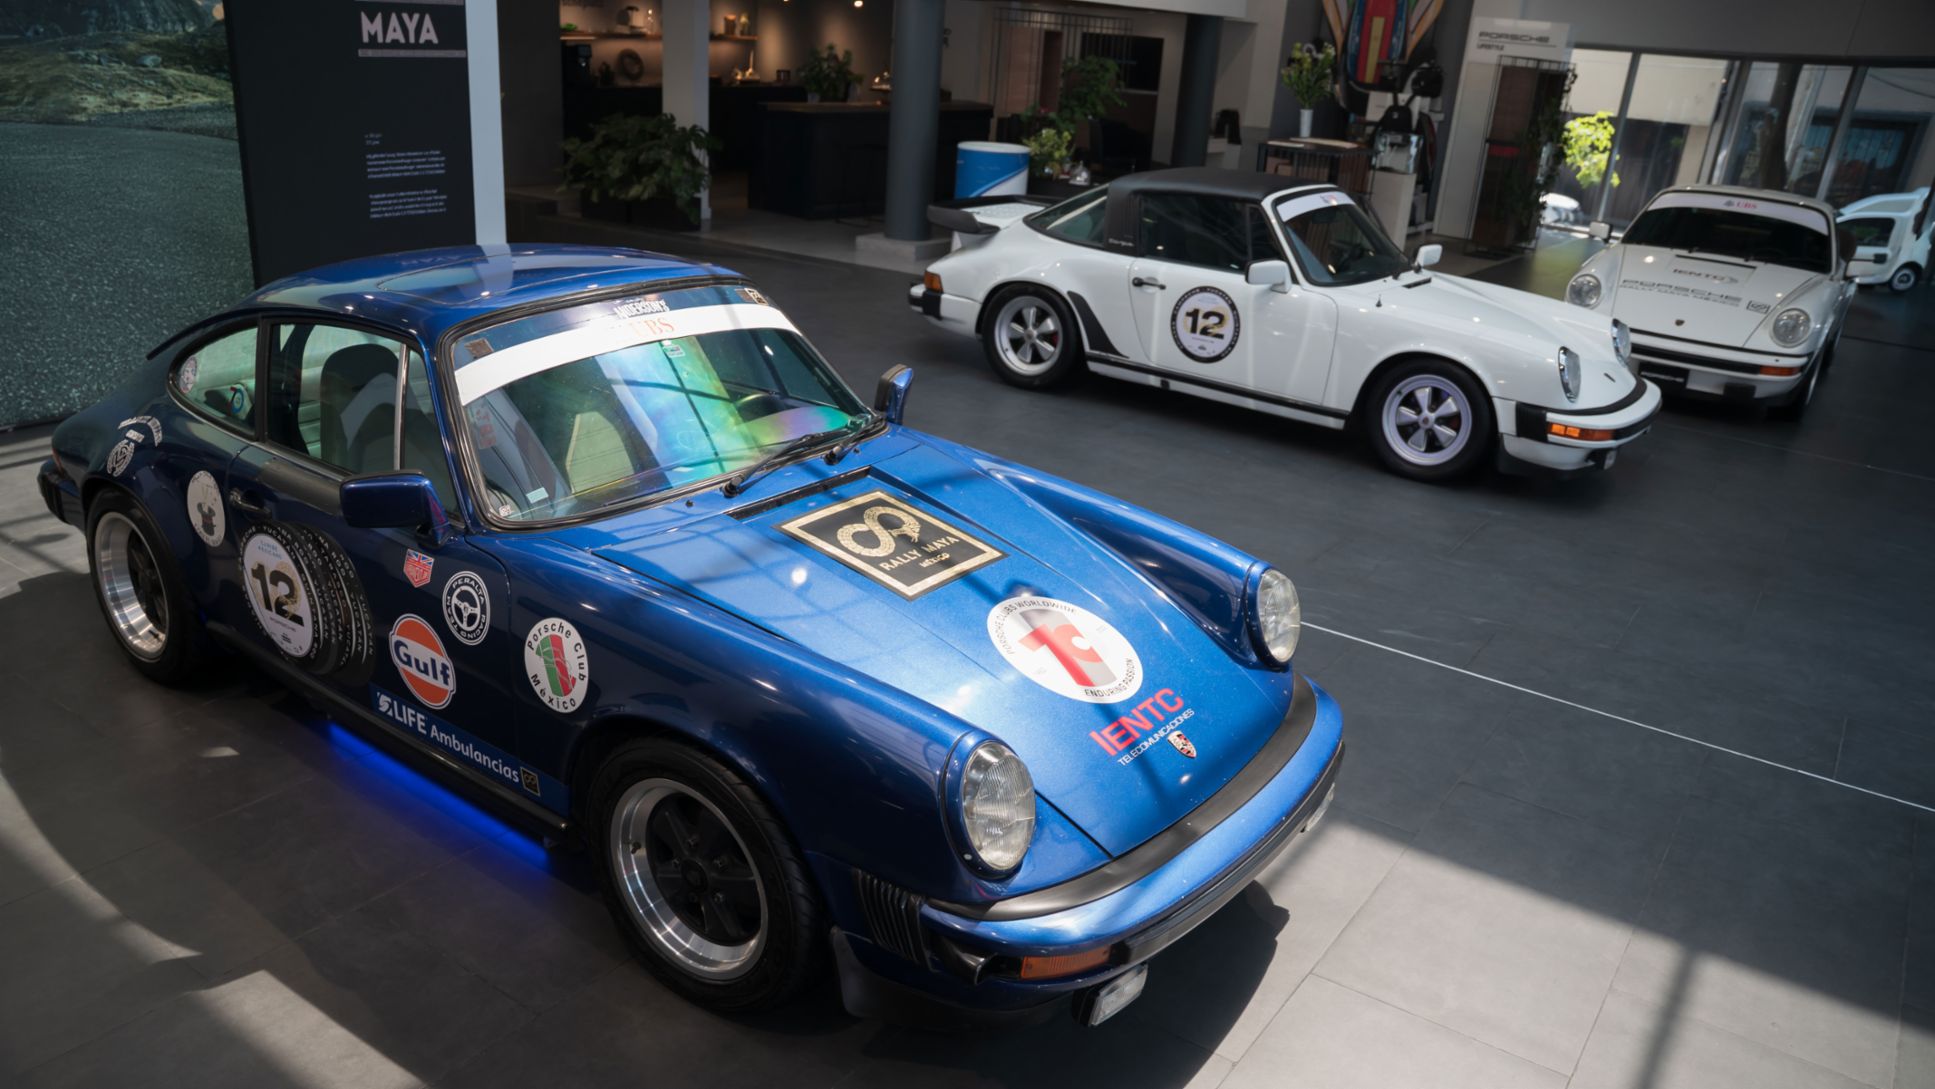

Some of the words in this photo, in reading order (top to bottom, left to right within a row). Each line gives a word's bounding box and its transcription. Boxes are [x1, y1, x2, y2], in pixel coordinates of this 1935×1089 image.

[360, 11, 439, 44] MAYA
[1479, 31, 1550, 43] PORSCHE
[1623, 278, 1742, 303] PORSCHE
[1185, 308, 1225, 340] 12
[879, 549, 922, 571] RALLY
[921, 536, 959, 553] MAYA
[251, 562, 305, 627] 12
[452, 577, 485, 605] PERALTA
[446, 596, 458, 630] TEAM
[460, 614, 486, 639] RACING
[394, 639, 450, 686] Gulf
[527, 622, 571, 651] Porsche
[574, 642, 586, 681] Club
[530, 673, 576, 710] México
[1084, 680, 1127, 698] ENDURING
[1124, 657, 1136, 687] PASSION
[1089, 687, 1185, 757] IENTC
[1117, 708, 1195, 766] TELECOMUNICACIONES
[393, 700, 427, 735] LIFE
[430, 724, 519, 783] Ambulancias
